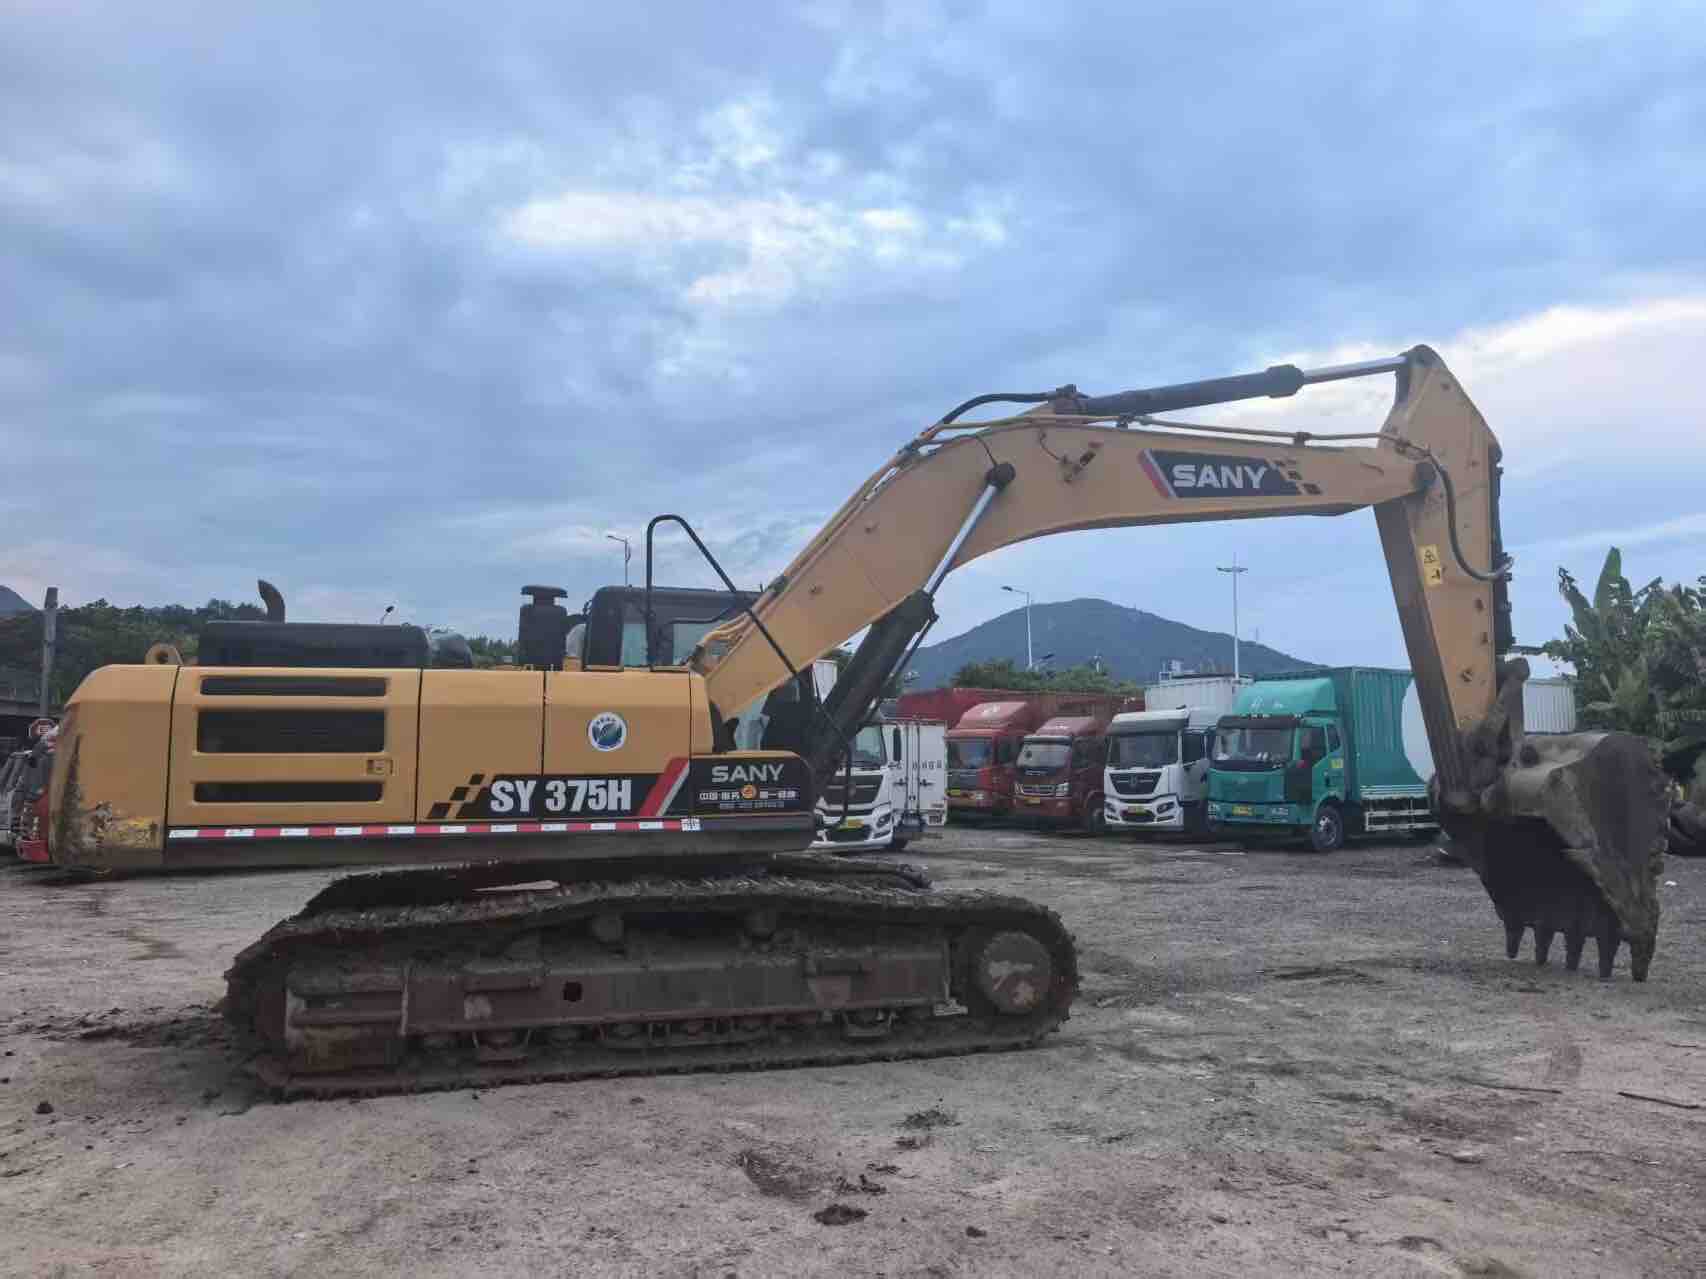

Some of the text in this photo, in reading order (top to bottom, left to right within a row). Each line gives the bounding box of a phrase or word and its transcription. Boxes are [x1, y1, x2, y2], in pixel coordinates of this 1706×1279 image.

[1172, 464, 1267, 489] SANY
[711, 764, 784, 783] SANY
[490, 779, 632, 812] SY 375H
